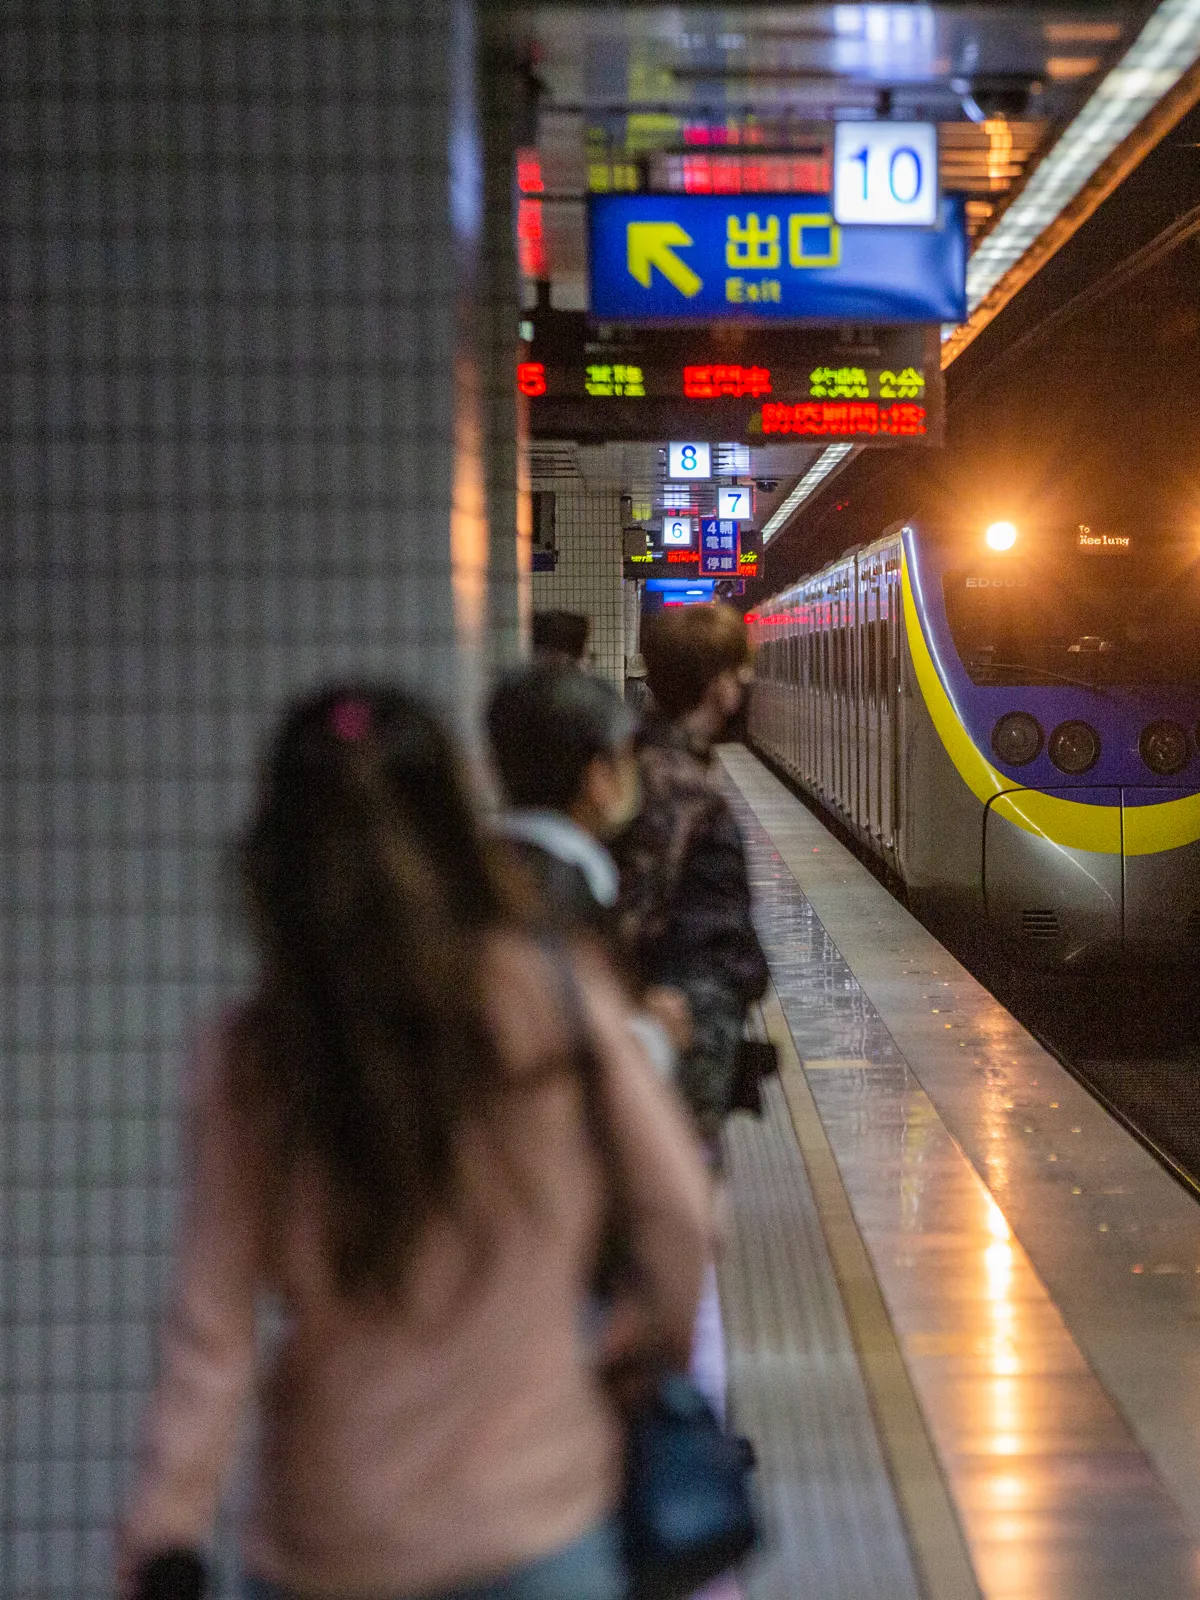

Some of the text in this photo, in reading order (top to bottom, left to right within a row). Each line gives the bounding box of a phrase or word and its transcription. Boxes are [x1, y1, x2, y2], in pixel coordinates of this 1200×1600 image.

[849, 144, 924, 203] 10
[726, 212, 842, 269] 出口
[725, 277, 782, 304] Exit
[681, 445, 697, 470] 8
[727, 493, 742, 513] 7
[672, 522, 682, 538] 6
[1078, 524, 1091, 534] To
[706, 537, 732, 549] 電車
[1079, 534, 1130, 547] Keelung
[706, 556, 733, 570] 停車
